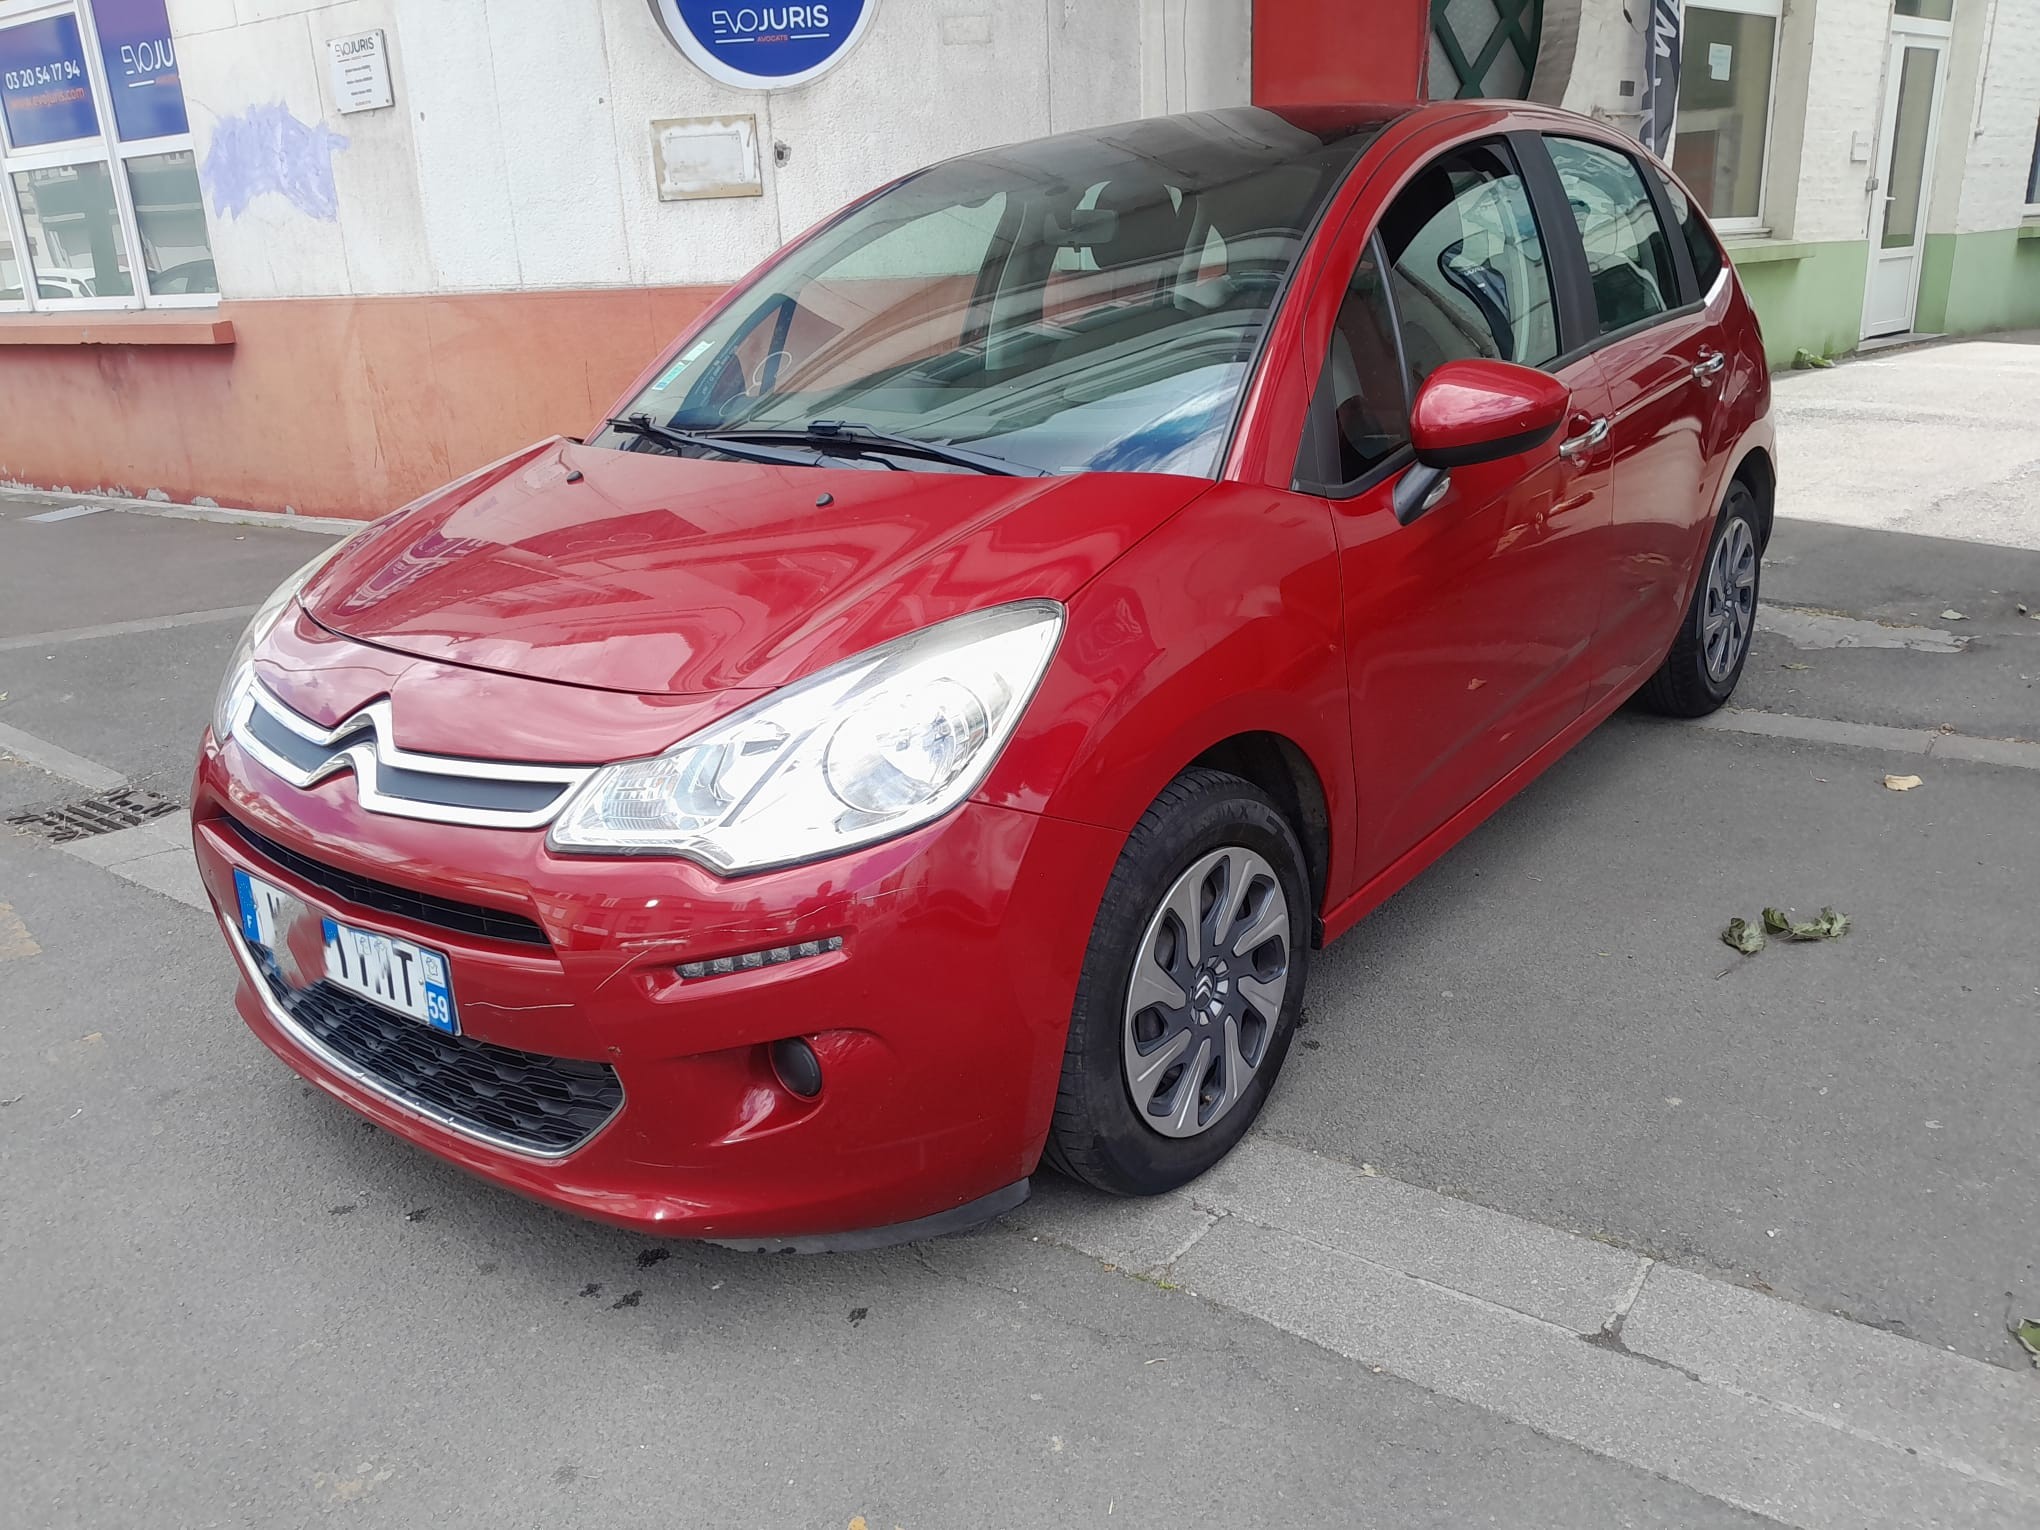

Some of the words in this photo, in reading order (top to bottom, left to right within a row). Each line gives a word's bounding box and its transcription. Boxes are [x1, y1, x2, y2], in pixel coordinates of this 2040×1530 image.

[712, 5, 829, 33] EVOJURIS
[334, 37, 375, 56] EVOJURIS
[757, 34, 788, 42] AVOCATS
[5, 71, 20, 90] 03
[20, 69, 35, 88] 20
[35, 65, 51, 85] 54
[50, 62, 62, 81] 17
[63, 60, 81, 79] 94
[11, 87, 85, 108] evojuris.com
[246, 914, 253, 929] F
[428, 990, 449, 1023] 59
